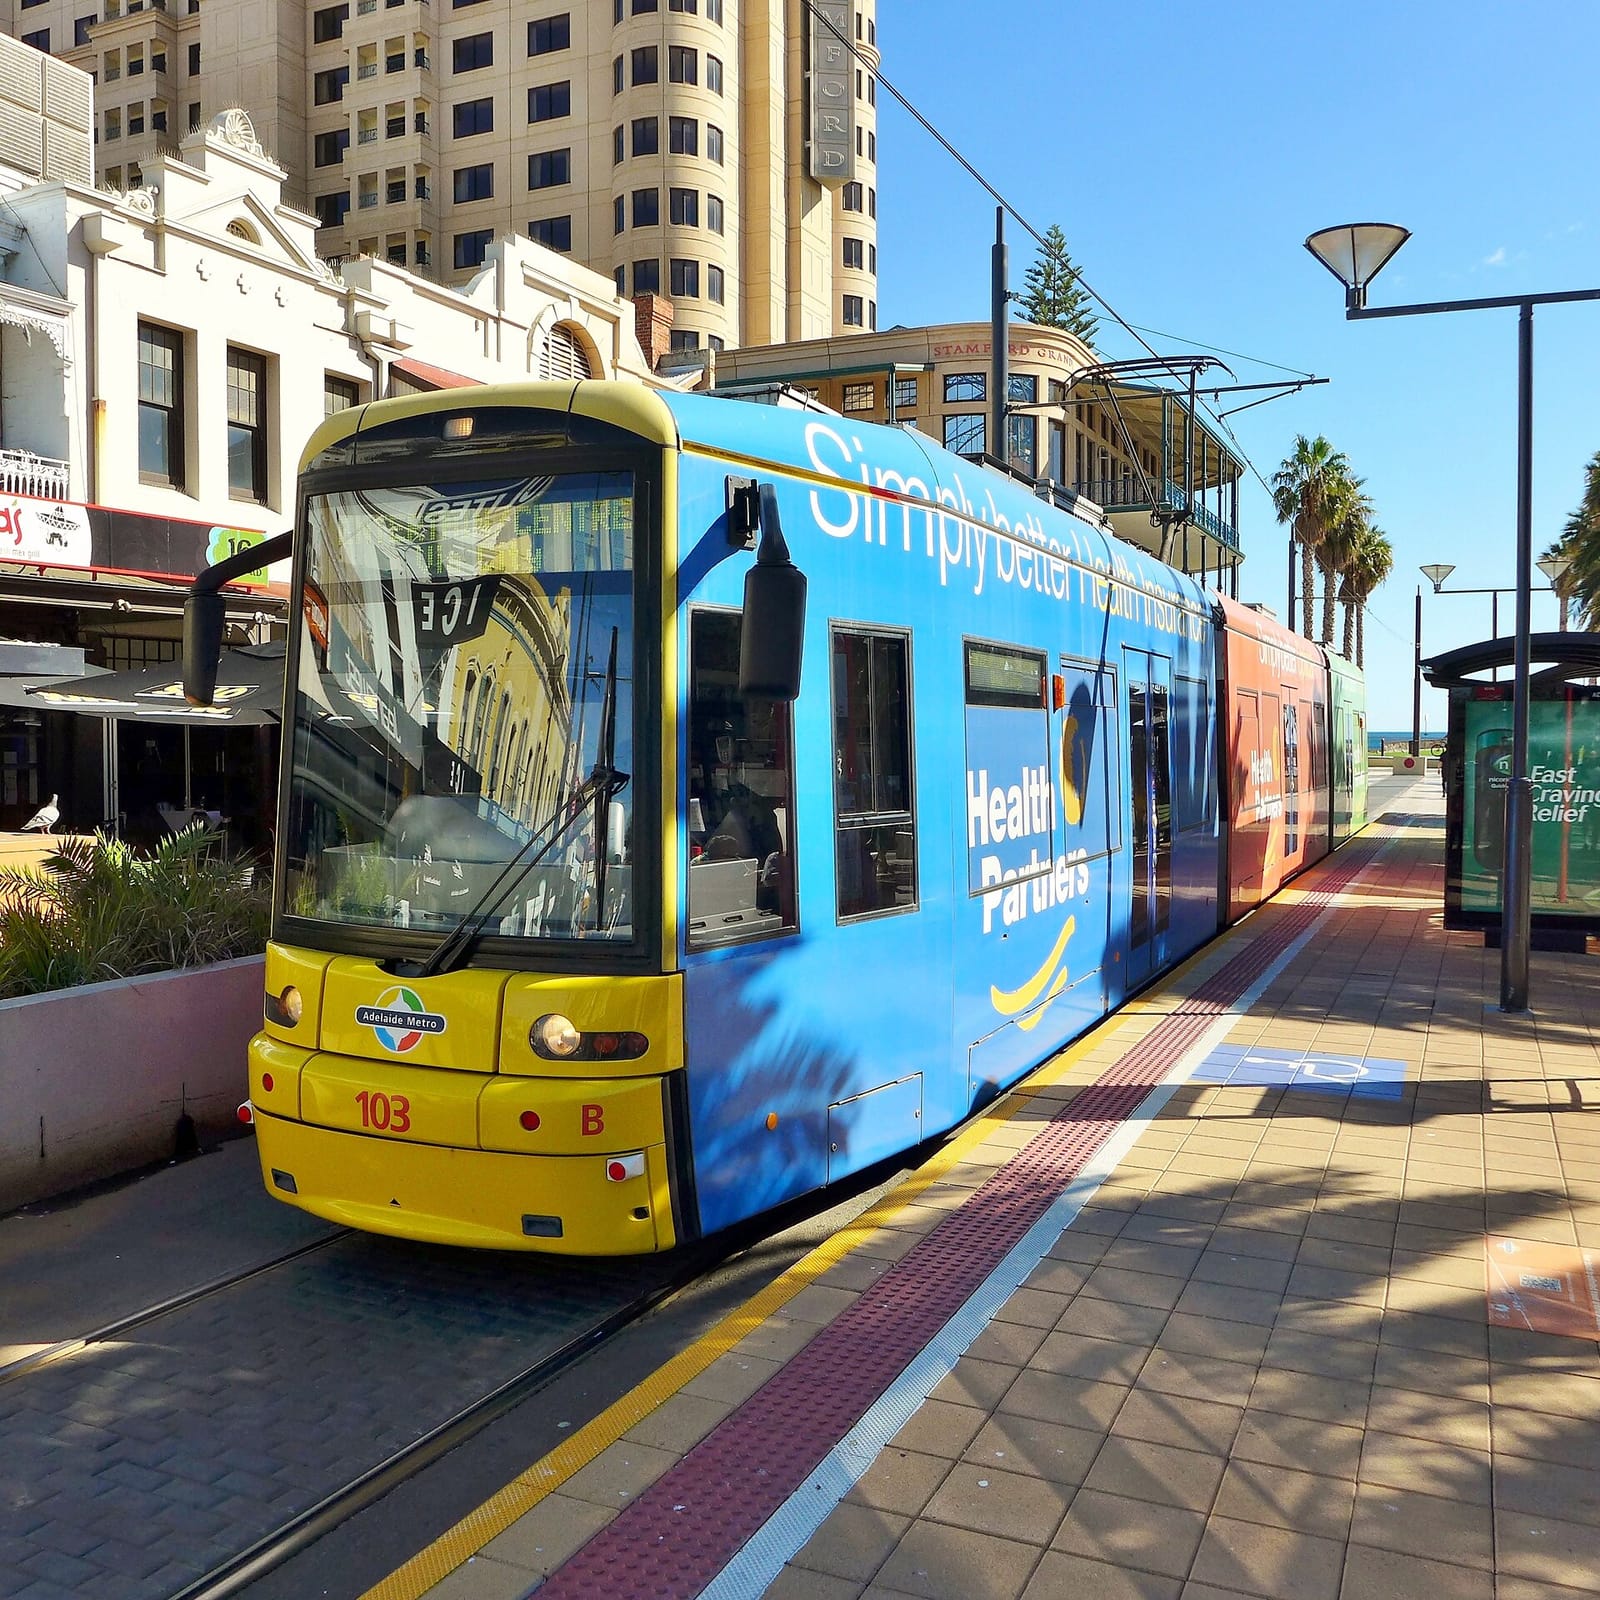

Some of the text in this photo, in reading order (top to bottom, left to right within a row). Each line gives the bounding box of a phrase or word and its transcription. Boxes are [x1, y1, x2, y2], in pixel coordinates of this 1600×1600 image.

[934, 343, 1074, 367] STAMFRD GRAND
[804, 422, 988, 596] Simply
[985, 488, 1071, 600] better
[1070, 529, 1139, 623] Health
[968, 765, 1056, 848] Health
[981, 845, 1089, 935] Partners
[363, 1011, 437, 1029] Adelaide Metro
[355, 1090, 411, 1133] 103
[581, 1104, 605, 1136] B
